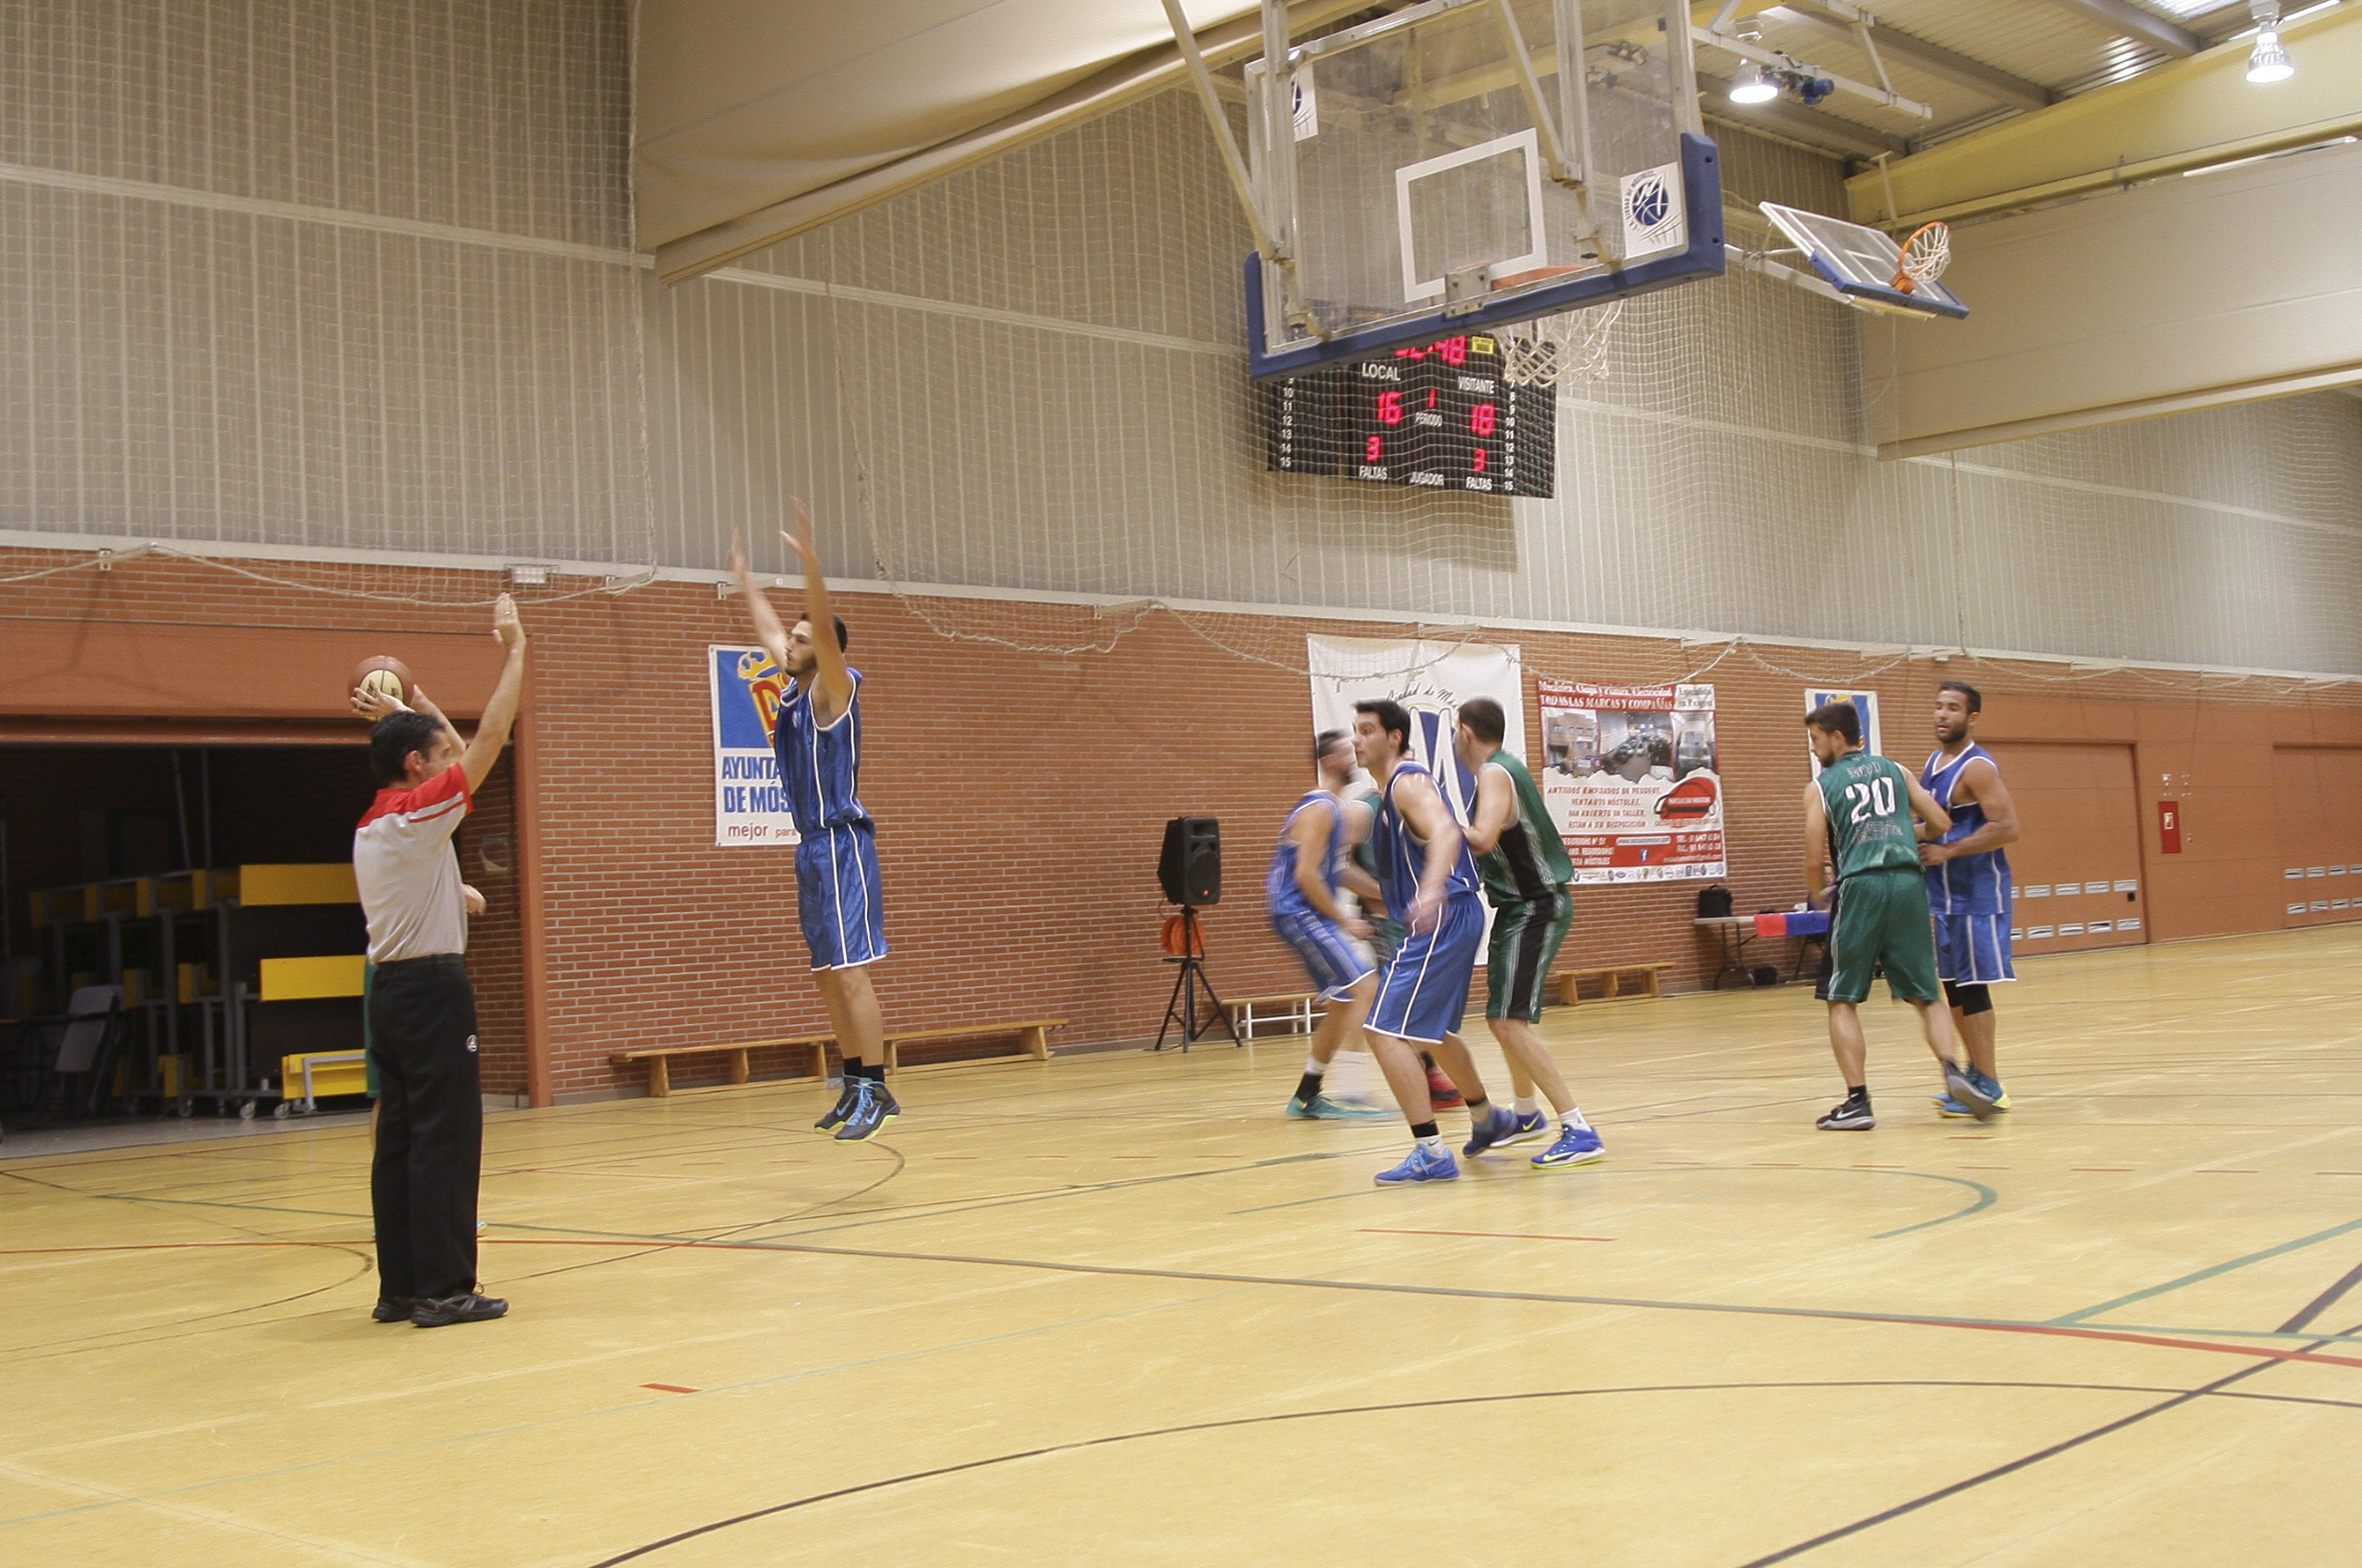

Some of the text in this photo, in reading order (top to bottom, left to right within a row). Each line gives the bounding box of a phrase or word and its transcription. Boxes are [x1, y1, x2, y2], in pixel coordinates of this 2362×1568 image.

[1362, 362, 1401, 381] LOCAL
[1458, 376, 1495, 394] VISITANTE
[1510, 379, 1516, 389] 7
[1283, 388, 1294, 398] 10
[1428, 389, 1437, 408] 1
[1510, 391, 1516, 401] 8
[1283, 400, 1292, 412] 11
[1378, 391, 1403, 425] 16
[1510, 404, 1515, 415] 9
[1282, 415, 1293, 426] 12
[1471, 403, 1496, 437] 18
[1505, 417, 1515, 427] 10
[1282, 428, 1292, 440] 13
[1505, 429, 1514, 440] 11
[1281, 443, 1291, 454] 14
[1367, 435, 1382, 462] 3
[1505, 442, 1514, 452] 12
[1280, 456, 1291, 468] 15
[1472, 448, 1487, 473] 3
[1504, 455, 1514, 466] 13
[1359, 465, 1388, 481] FALTAS
[1409, 471, 1445, 486] JUGADOR
[1504, 468, 1514, 478] 14
[1465, 476, 1493, 491] FALTAS
[1504, 480, 1514, 491] 15
[1539, 695, 1568, 706] TODAS
[1569, 697, 1584, 707] LAS
[1584, 698, 1620, 708] MARCAS
[1621, 699, 1629, 708] Y
[722, 756, 780, 780] AYUNTA
[724, 786, 746, 813] DE
[1845, 776, 1896, 825] 20
[728, 823, 769, 840] mejor
